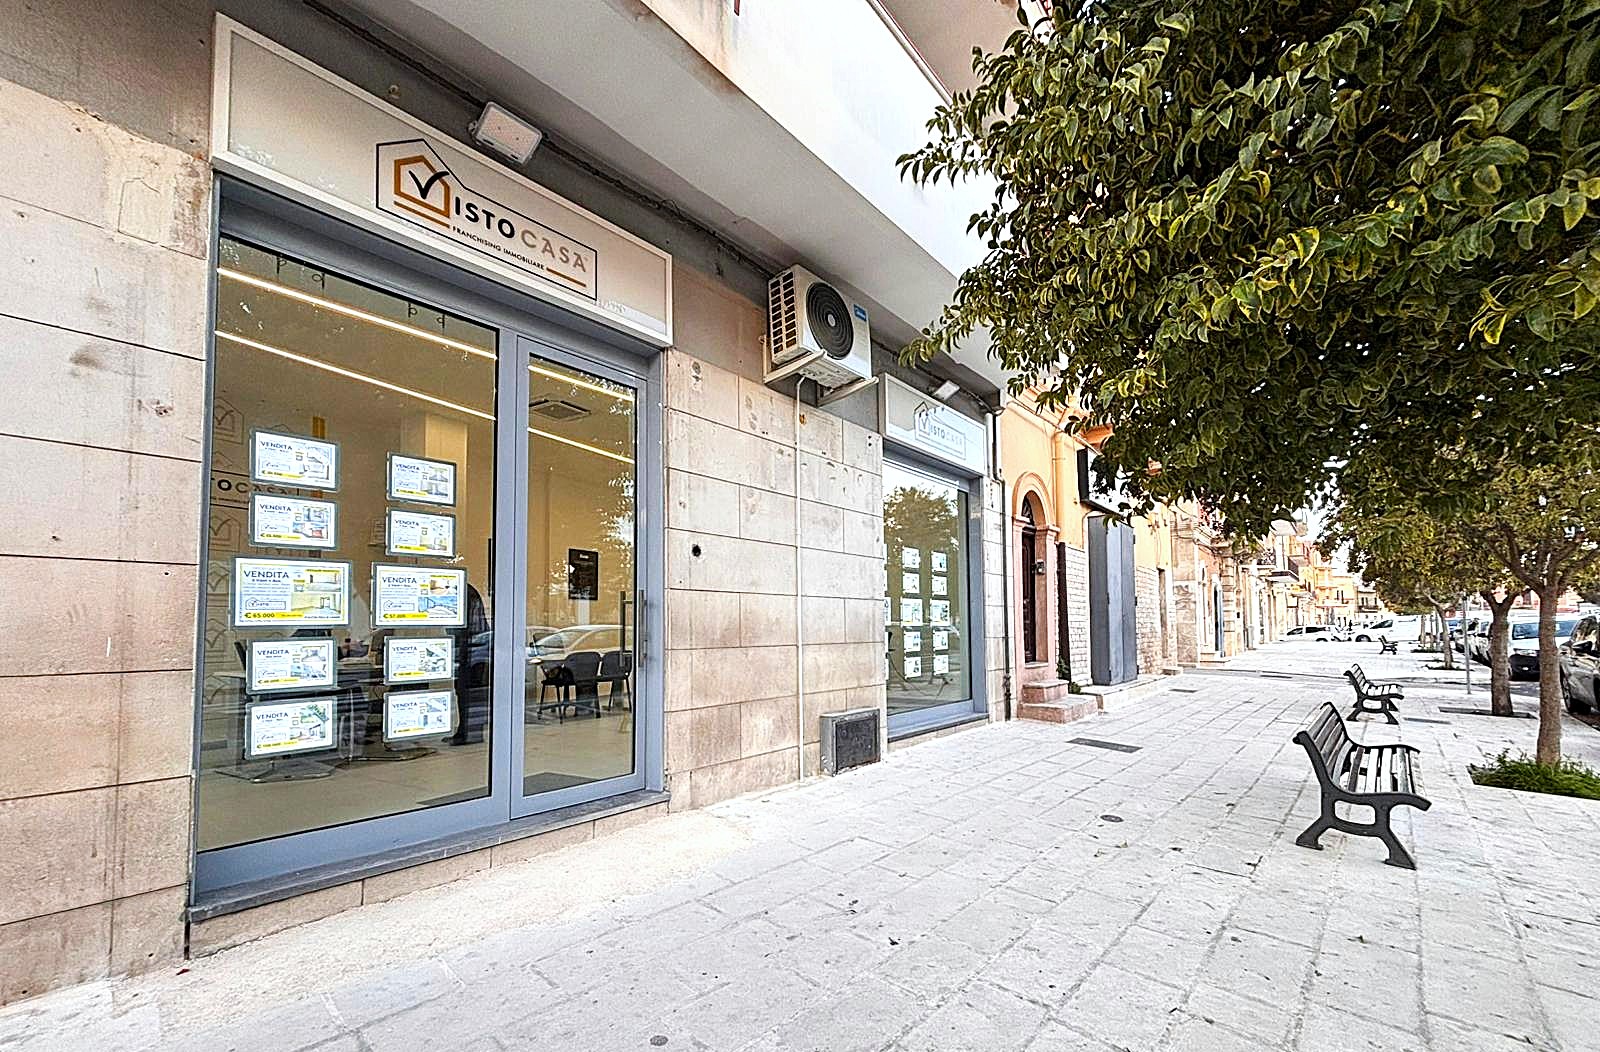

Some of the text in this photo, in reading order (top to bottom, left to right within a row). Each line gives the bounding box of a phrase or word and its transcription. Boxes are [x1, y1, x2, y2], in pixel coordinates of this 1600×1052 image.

[452, 225, 545, 270] FRANCHISING IMMOBILIARE
[260, 441, 293, 450] VENDITA
[243, 570, 290, 579] VENDITA
[382, 576, 418, 584] VENDITA
[256, 712, 289, 720] VENDITA
